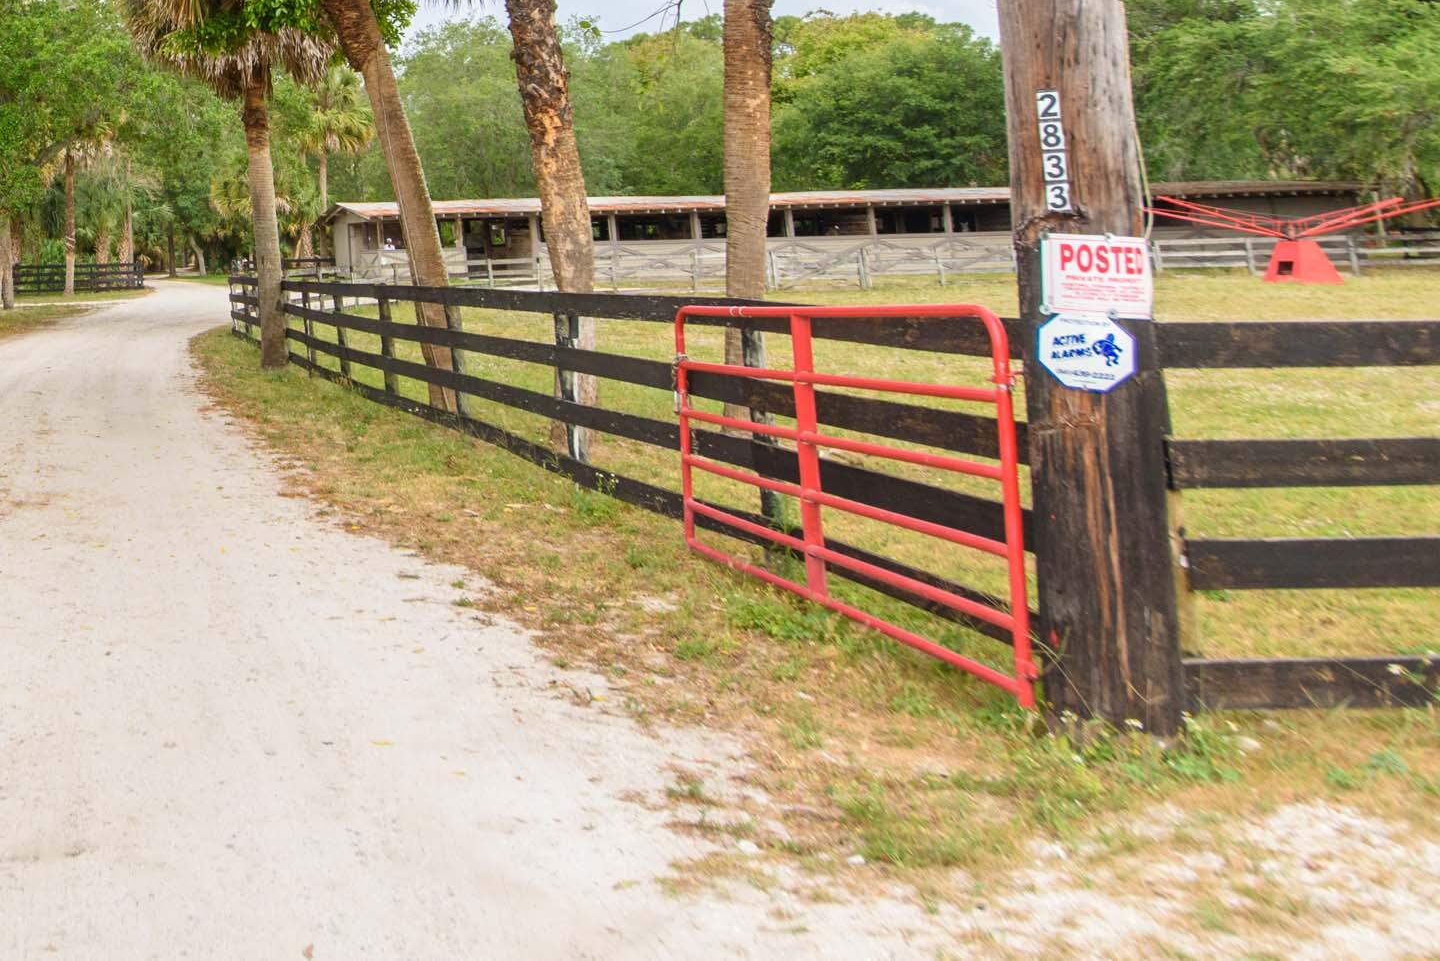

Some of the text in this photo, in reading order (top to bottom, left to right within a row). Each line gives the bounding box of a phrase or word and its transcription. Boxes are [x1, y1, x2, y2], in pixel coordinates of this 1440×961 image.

[1037, 94, 1067, 209] 2833
[1060, 243, 1143, 275] POSTED
[1053, 334, 1085, 346] ACTIVE
[1051, 347, 1092, 359] ALARMS
